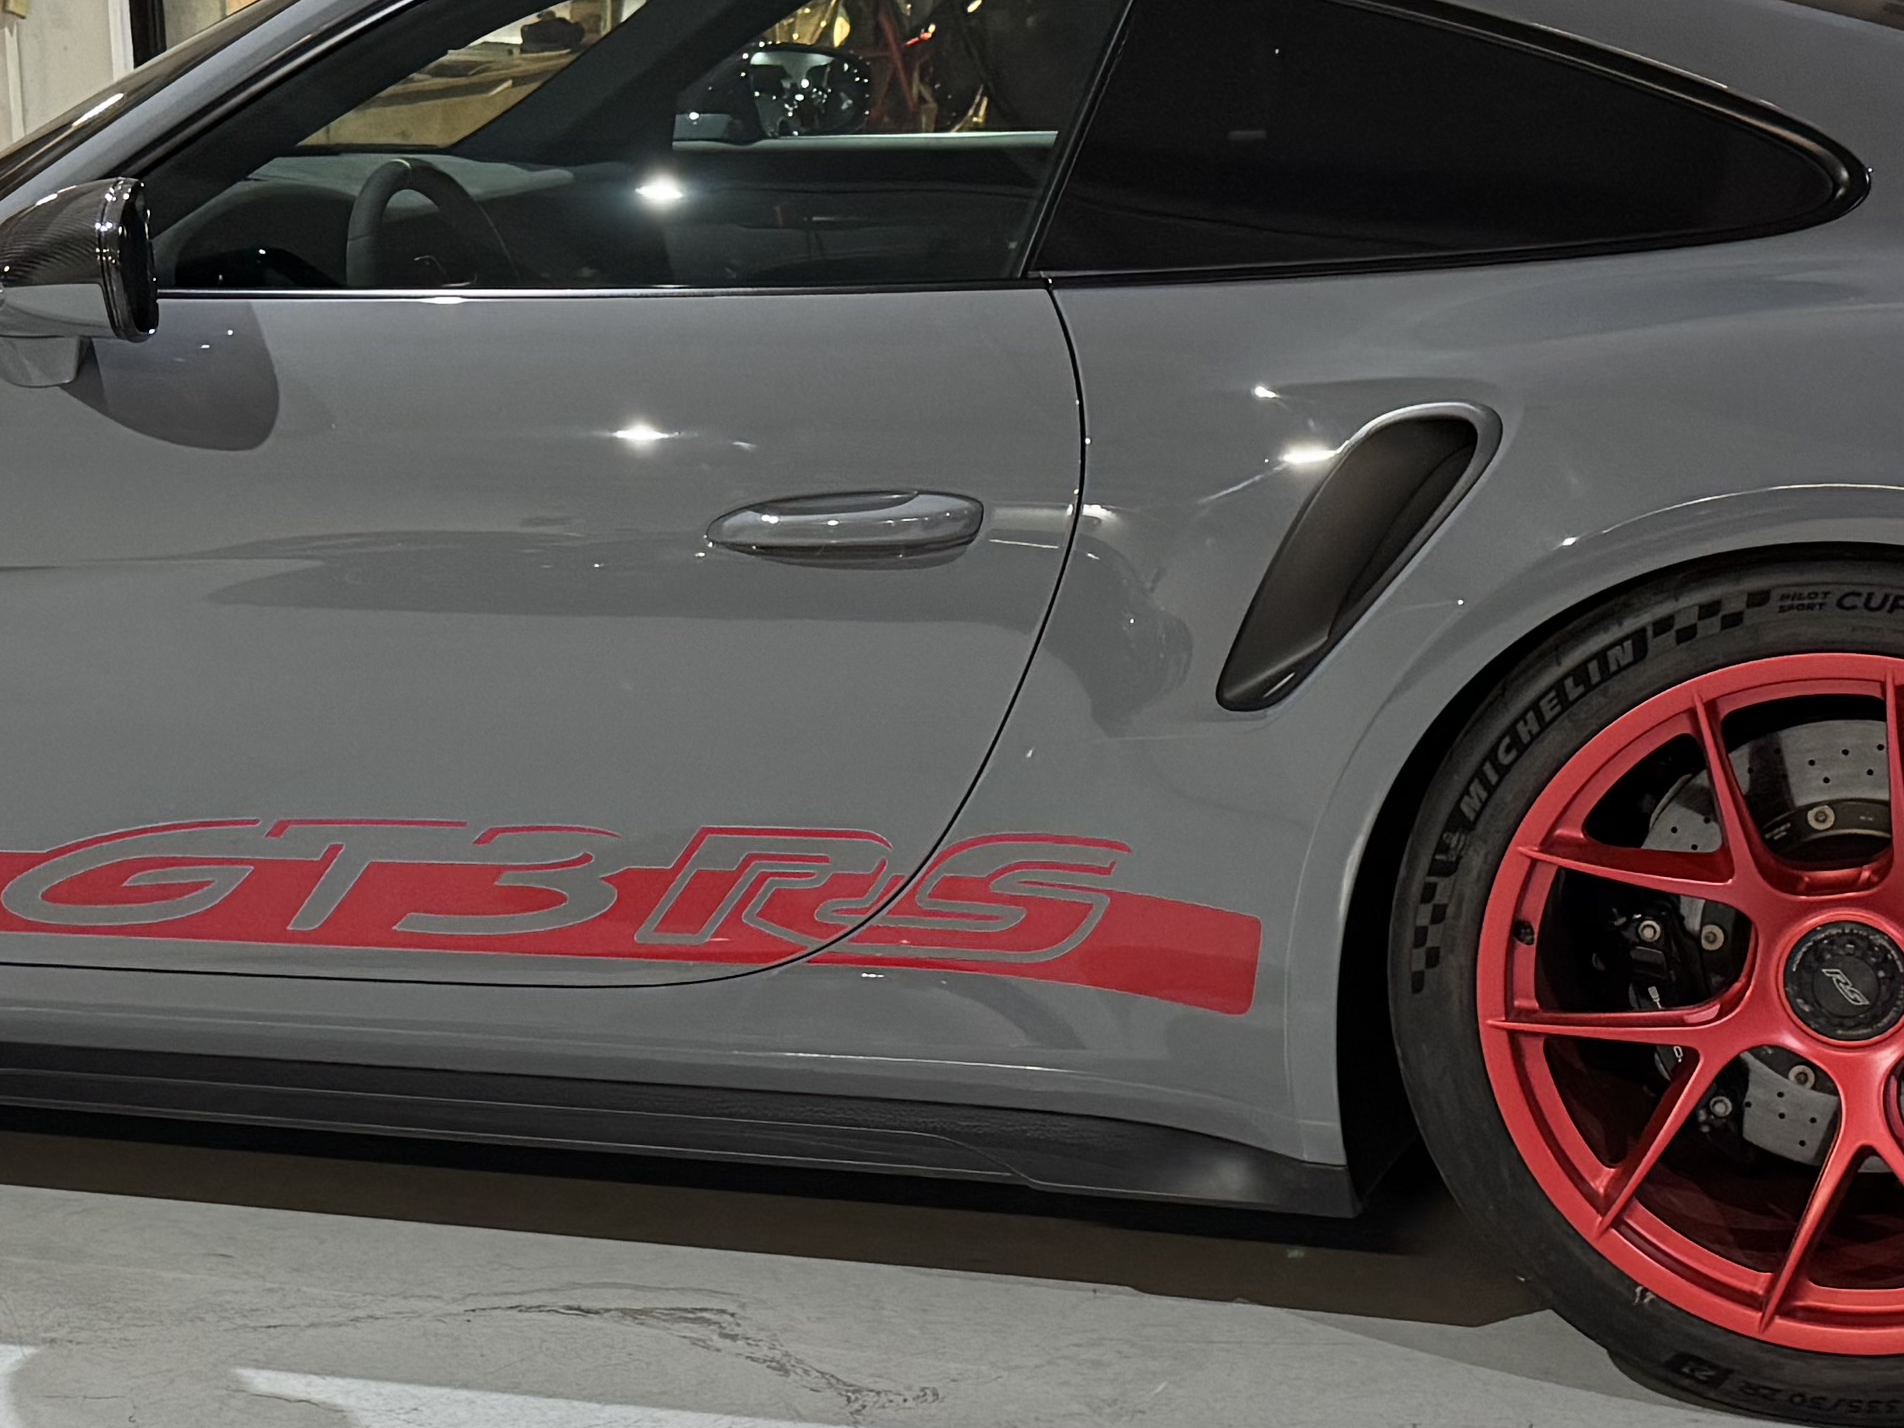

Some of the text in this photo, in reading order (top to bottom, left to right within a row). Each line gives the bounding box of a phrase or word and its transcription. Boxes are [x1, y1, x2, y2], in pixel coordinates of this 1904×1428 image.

[1777, 602, 1828, 614] SPORT
[1778, 590, 1832, 602] PILOT
[1459, 639, 1635, 823] MICHELIN
[1821, 968, 1871, 1005] RS
